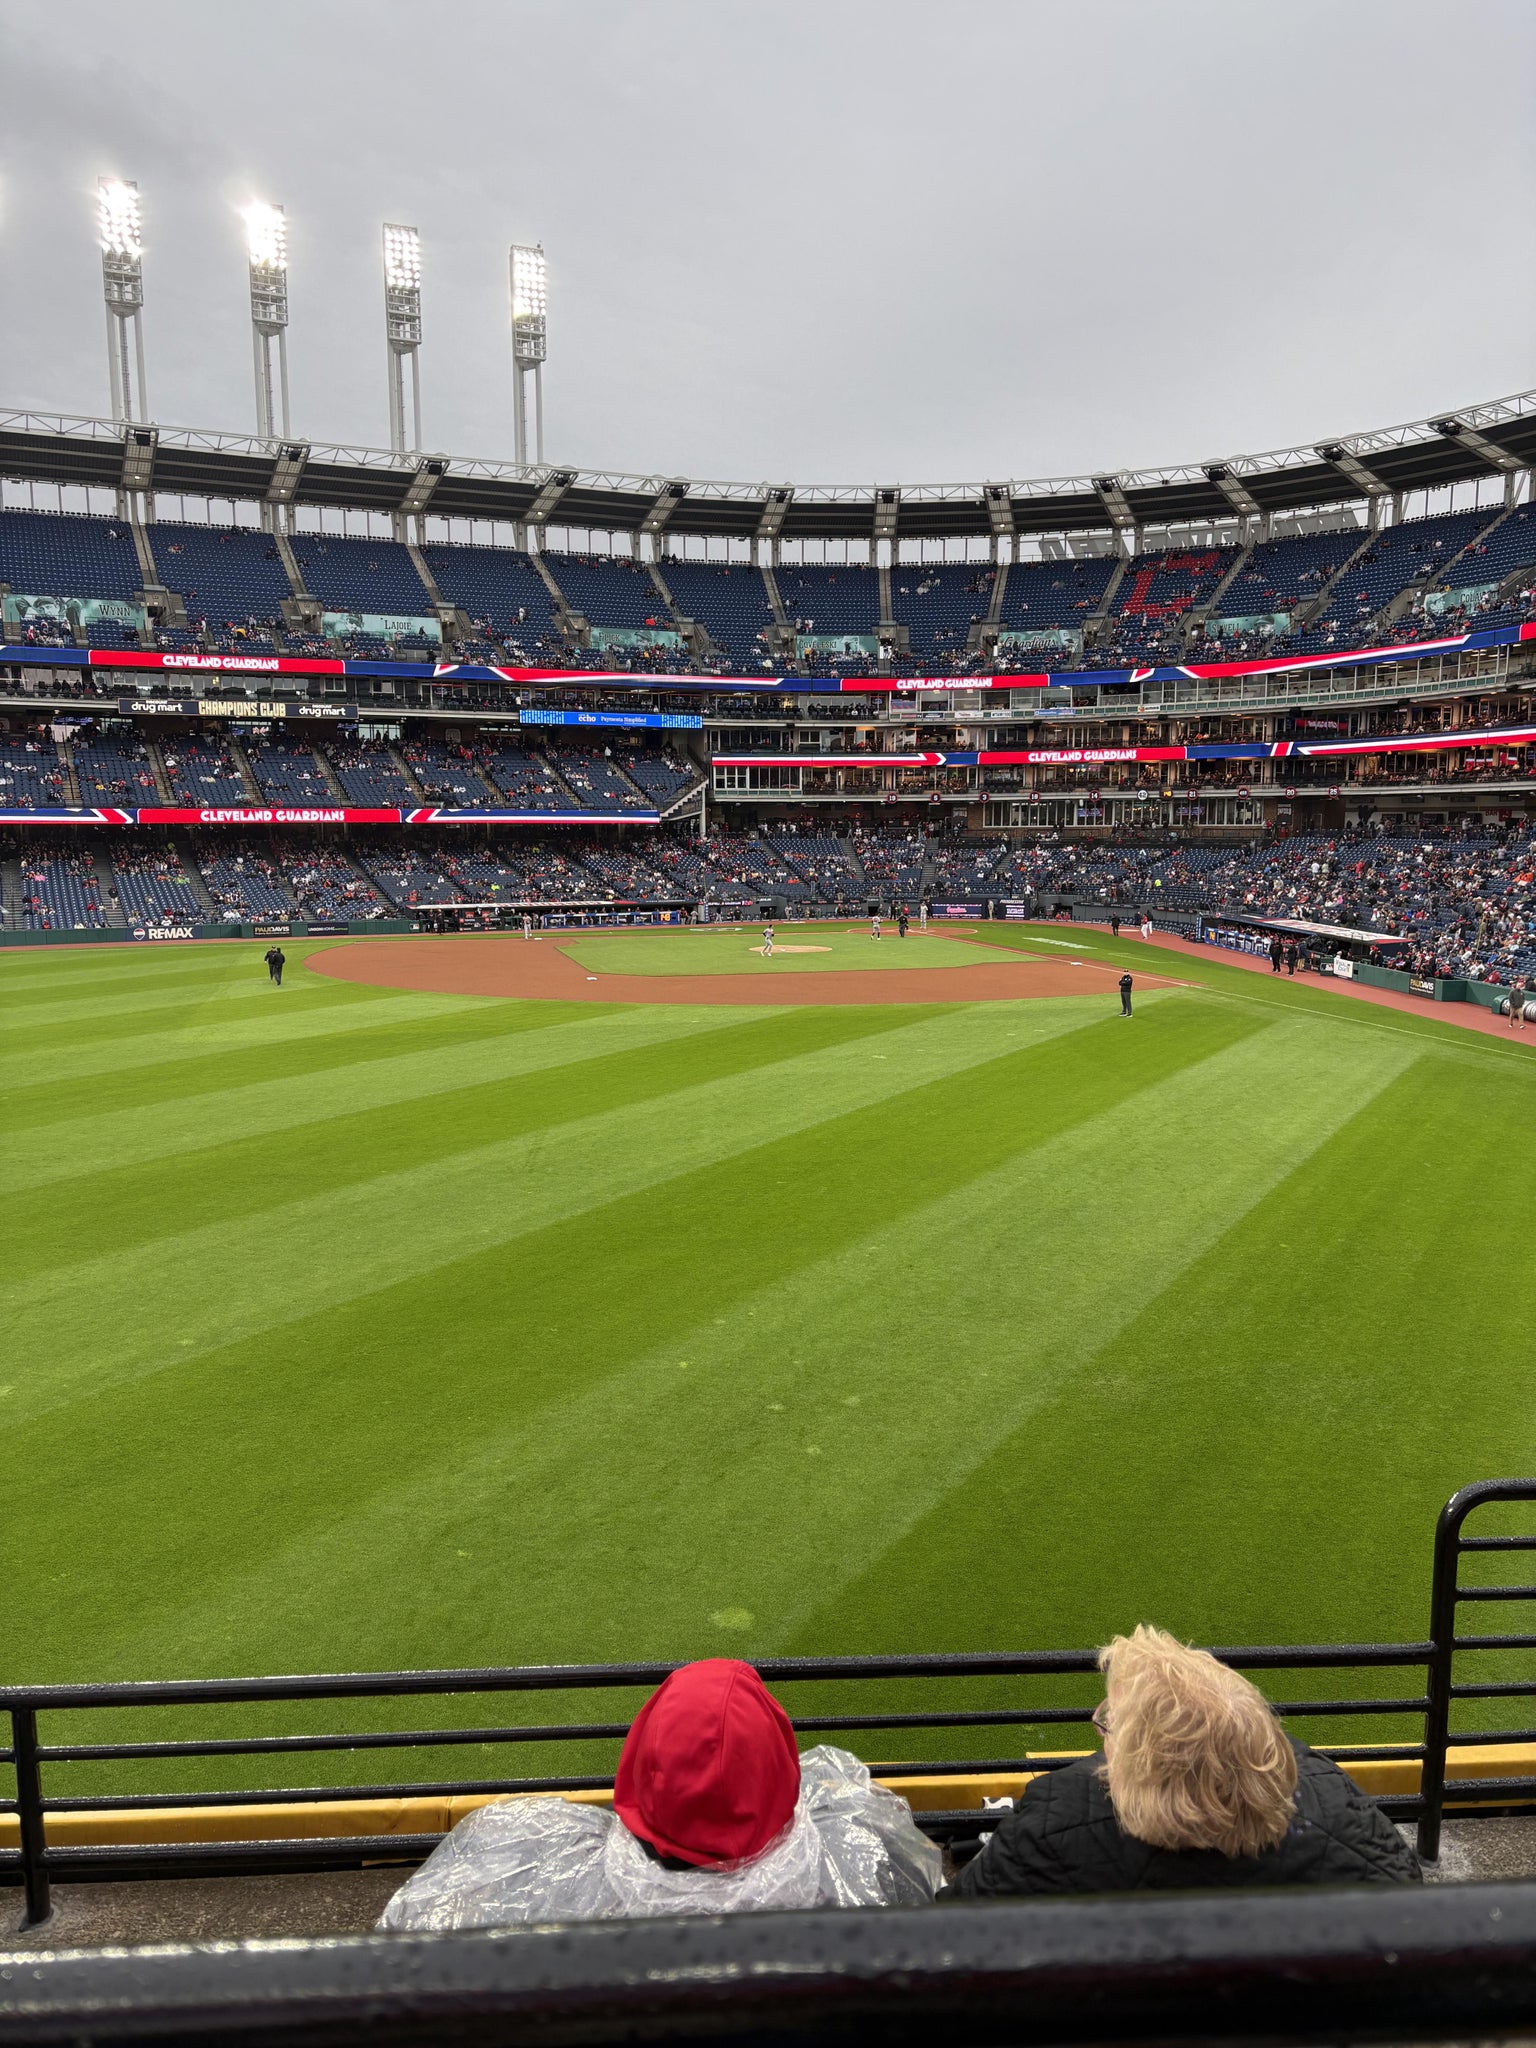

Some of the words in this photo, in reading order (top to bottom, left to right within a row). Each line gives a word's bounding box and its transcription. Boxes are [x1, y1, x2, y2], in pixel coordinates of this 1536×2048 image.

[98, 604, 131, 617] WYNN
[384, 619, 412, 631] LAJOIE
[162, 655, 222, 667] CLEVELAND
[222, 657, 280, 670] GUARDIANS
[896, 679, 944, 689] CLEVELAND
[945, 677, 993, 688] GUARDIANS
[131, 702, 155, 714] drug
[157, 703, 183, 712] mart
[198, 701, 258, 717] CHAMPIONS
[260, 703, 287, 717] CLUB
[298, 706, 321, 718] drug
[322, 707, 346, 716] mart
[578, 714, 596, 722] echo
[1028, 751, 1082, 762] CLEVELAND
[1083, 749, 1137, 761] GUARDIANS
[200, 810, 273, 821] CLEVELAND
[275, 810, 345, 821] GUARDIANS
